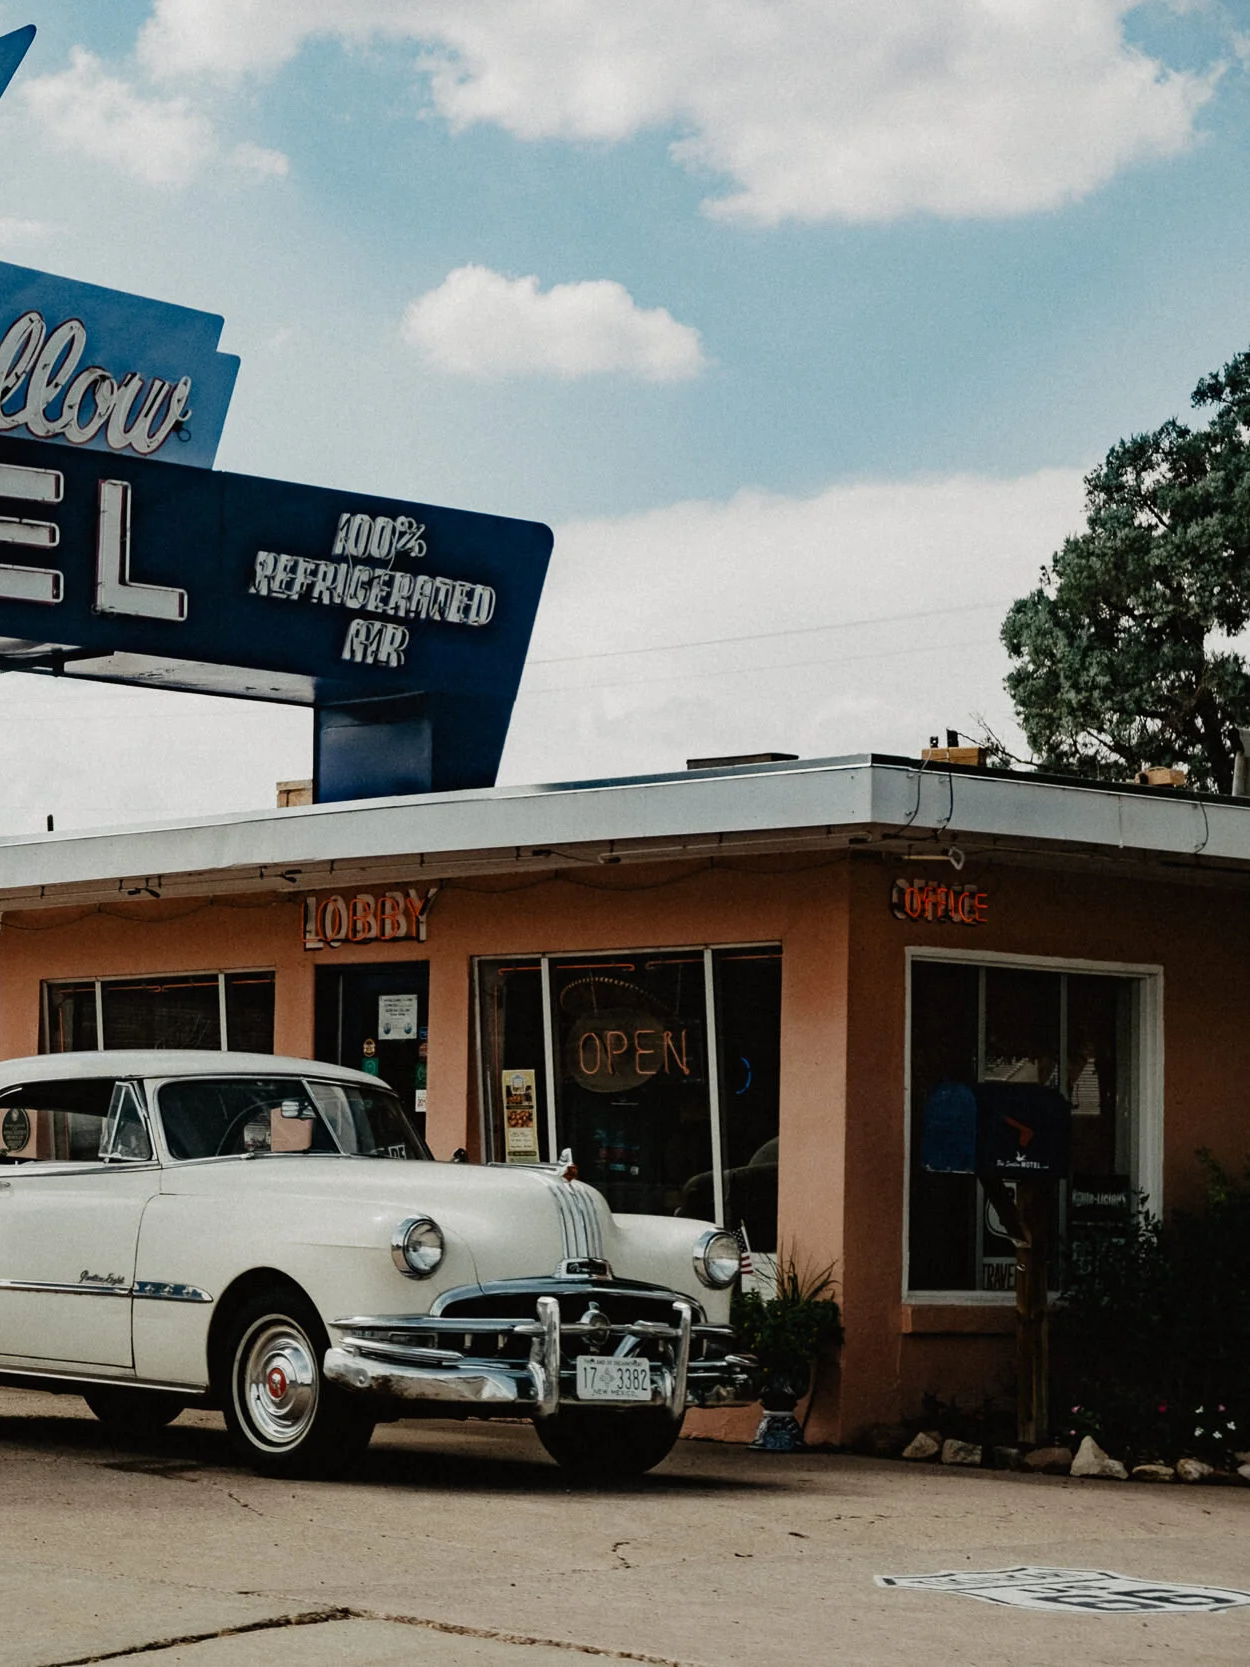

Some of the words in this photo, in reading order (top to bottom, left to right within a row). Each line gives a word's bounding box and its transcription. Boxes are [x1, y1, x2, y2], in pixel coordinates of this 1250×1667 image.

[332, 513, 427, 559] 100%
[249, 550, 497, 627] REFRIGERATED
[341, 618, 410, 668] AIR
[301, 887, 438, 951] LOBBY
[891, 878, 989, 924] OFFICE
[578, 1029, 691, 1077] OPEN
[583, 1367, 598, 1389] 17
[616, 1368, 648, 1391] 3382
[1031, 1589, 1237, 1611] 66
